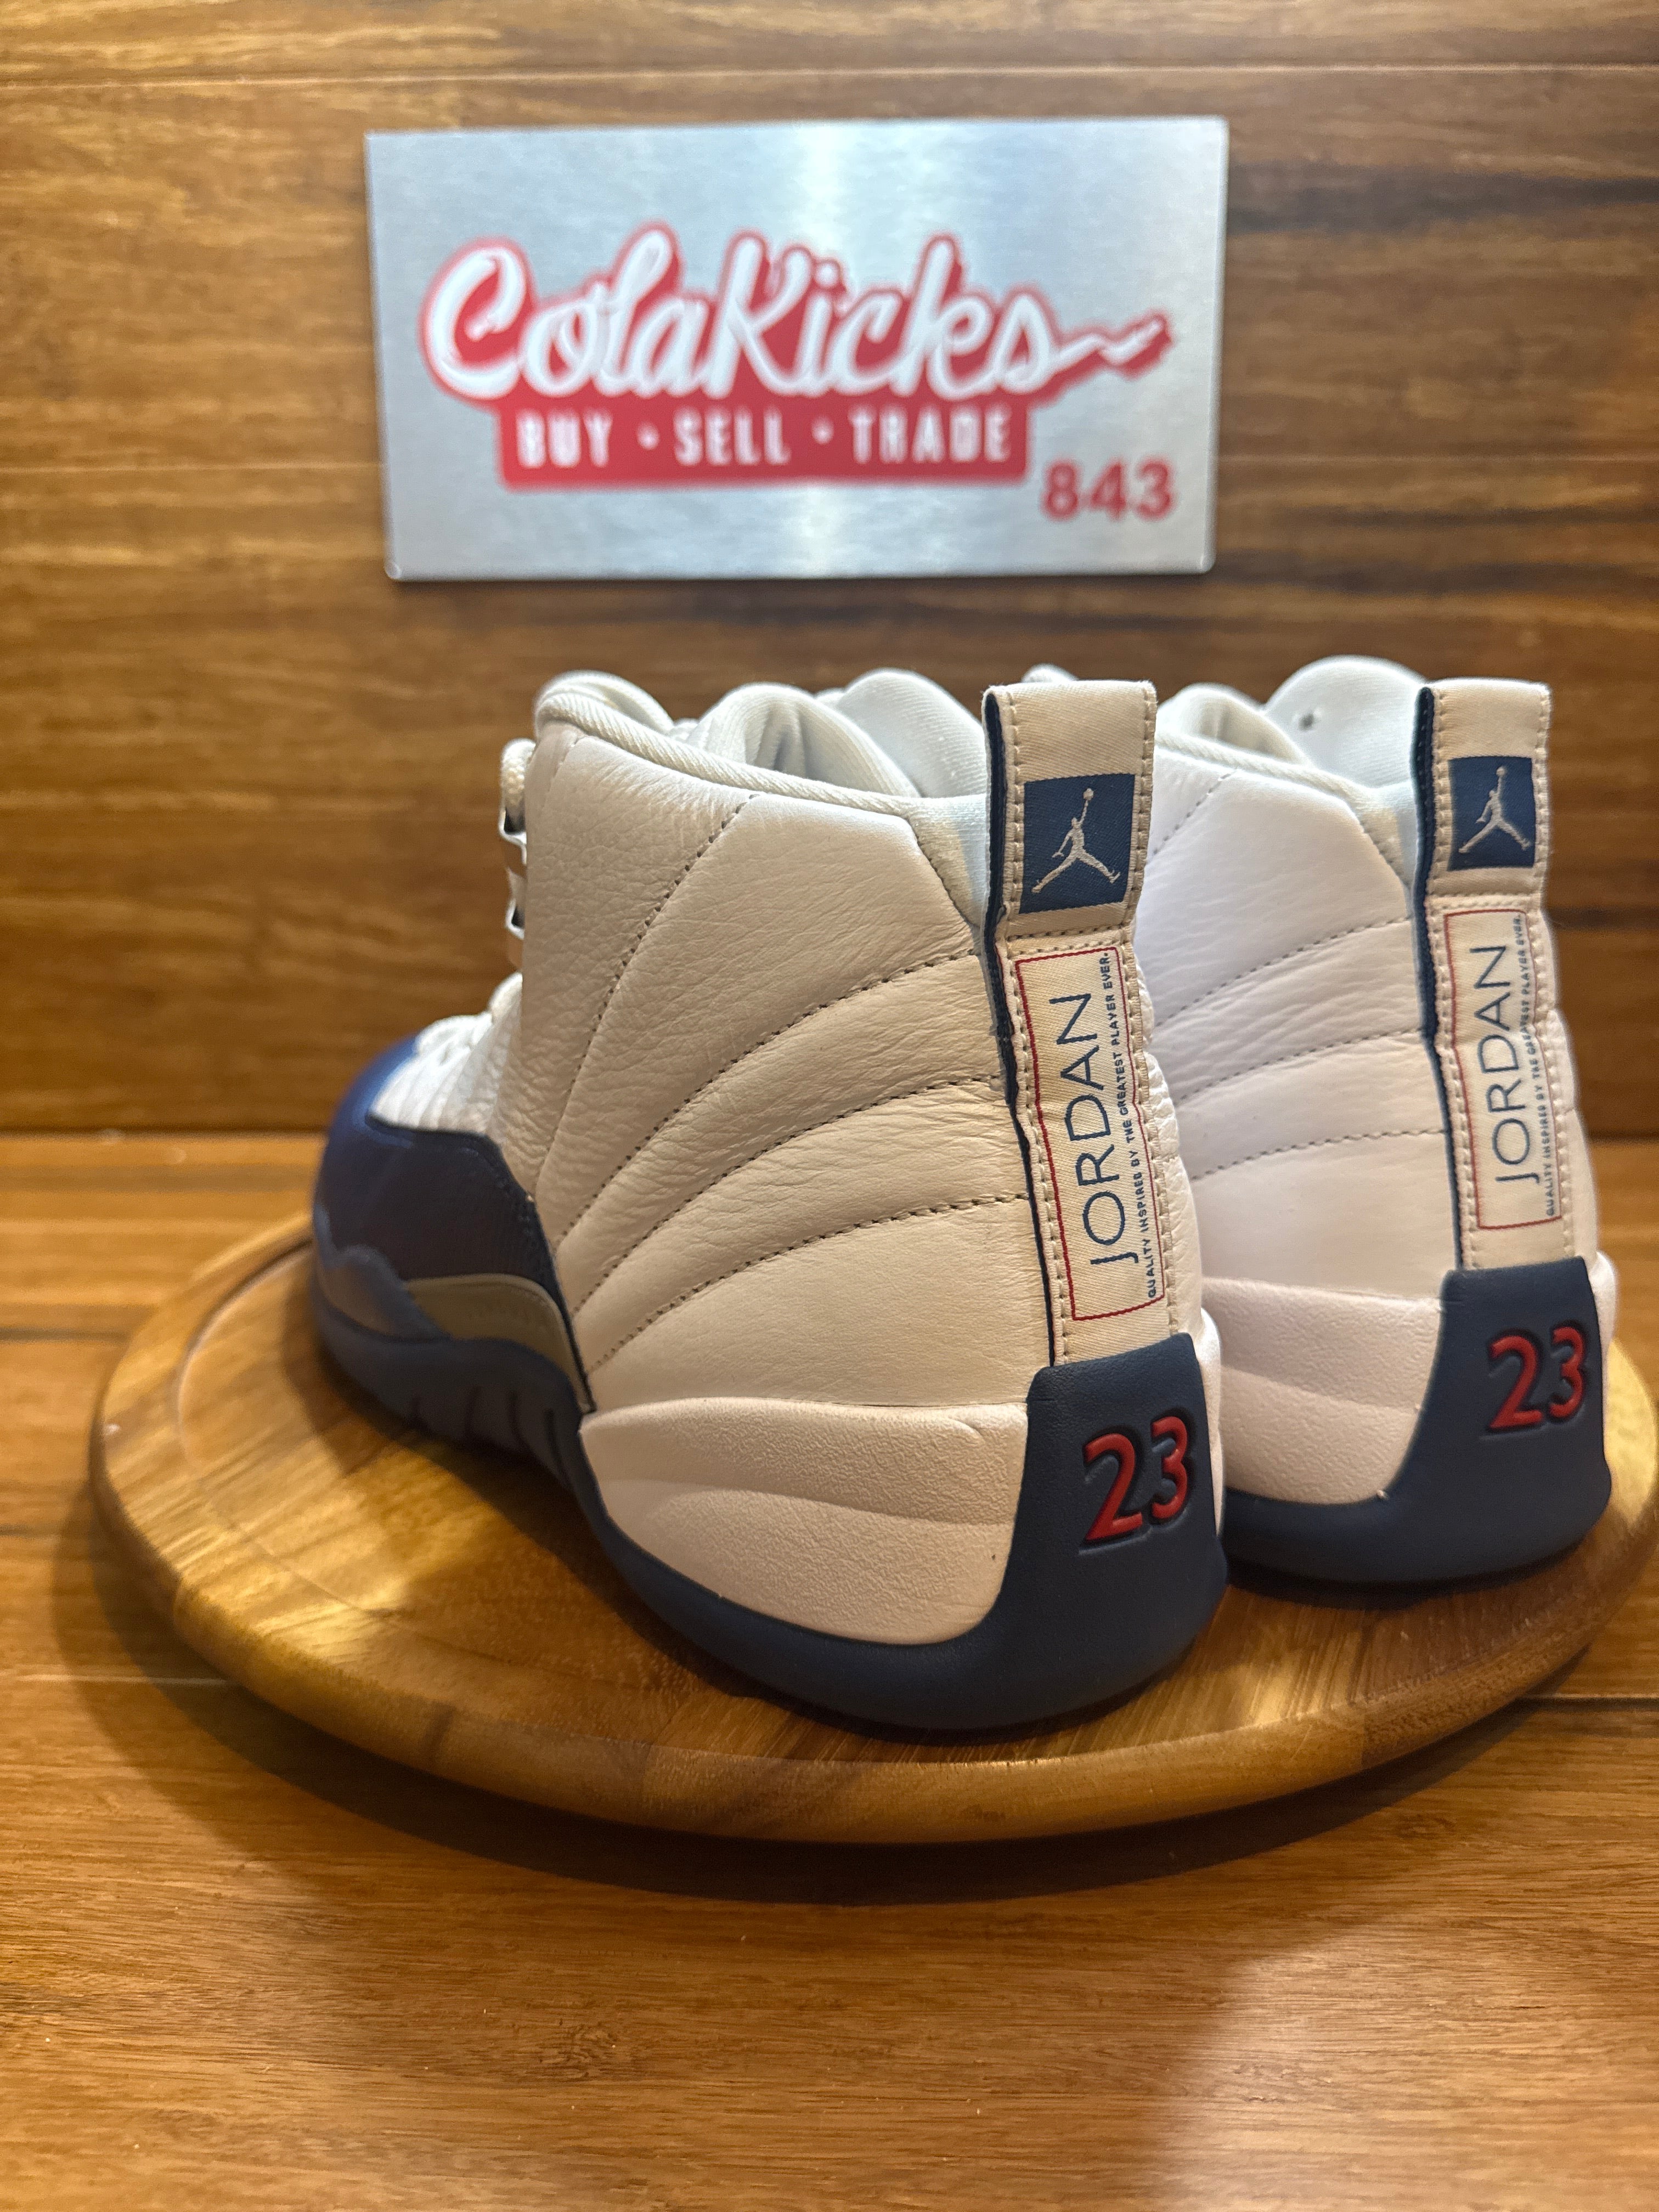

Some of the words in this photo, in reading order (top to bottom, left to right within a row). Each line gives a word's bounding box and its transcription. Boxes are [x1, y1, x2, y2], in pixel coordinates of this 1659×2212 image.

[424, 223, 1169, 399] ColaKicks
[516, 408, 614, 468] BUY
[674, 408, 791, 466] SELL
[849, 407, 1012, 462] TRADE
[1042, 460, 1175, 520] 843
[1098, 952, 1114, 990] EVER.
[1105, 994, 1121, 1046] PLAYER
[1113, 1052, 1130, 1116] GREATEST
[1470, 945, 1541, 1184] JORDAN
[1536, 1085, 1545, 1100] BY
[1048, 991, 1139, 1266] JORDAN
[1122, 1119, 1136, 1143] THE
[1128, 1150, 1141, 1167] BY
[1537, 1104, 1550, 1159] INSPIRED
[1132, 1171, 1149, 1233] INSPIRED
[1543, 1163, 1555, 1216] QUALITY
[1142, 1238, 1156, 1299] QUALITY
[1487, 1325, 1587, 1431] 23
[1082, 1414, 1190, 1541] 23
